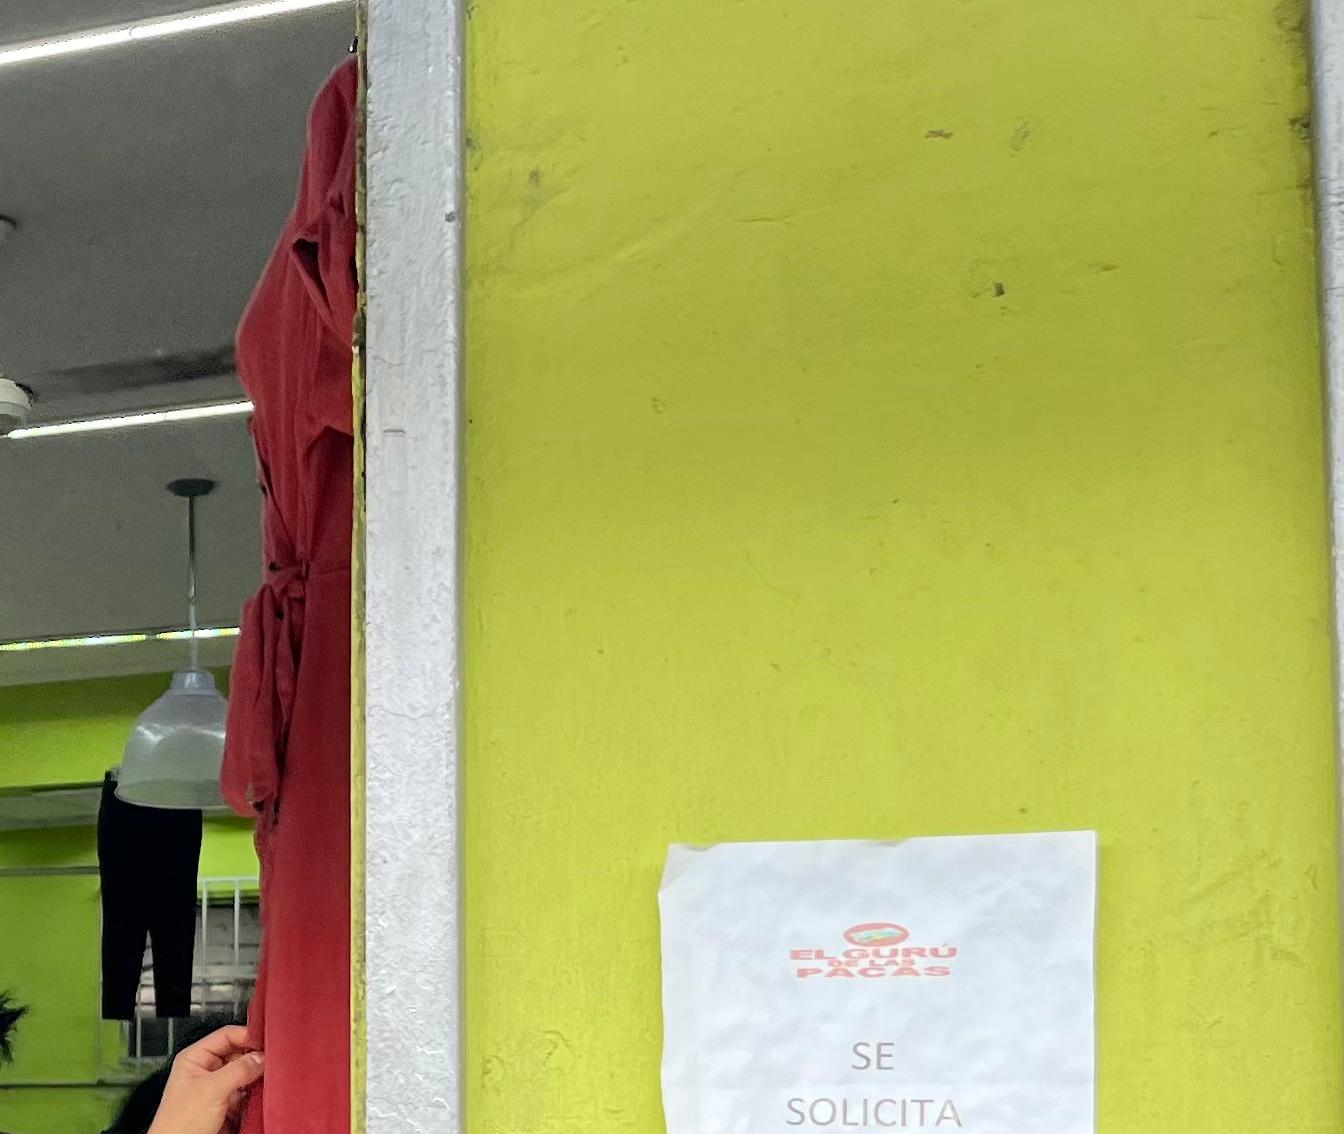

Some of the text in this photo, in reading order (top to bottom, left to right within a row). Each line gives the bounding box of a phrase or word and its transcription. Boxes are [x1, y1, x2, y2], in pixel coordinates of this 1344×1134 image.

[790, 948, 836, 961] EL
[796, 966, 951, 978] PACAS
[851, 1041, 895, 1070] SE
[786, 1097, 963, 1128] SOLICITA
